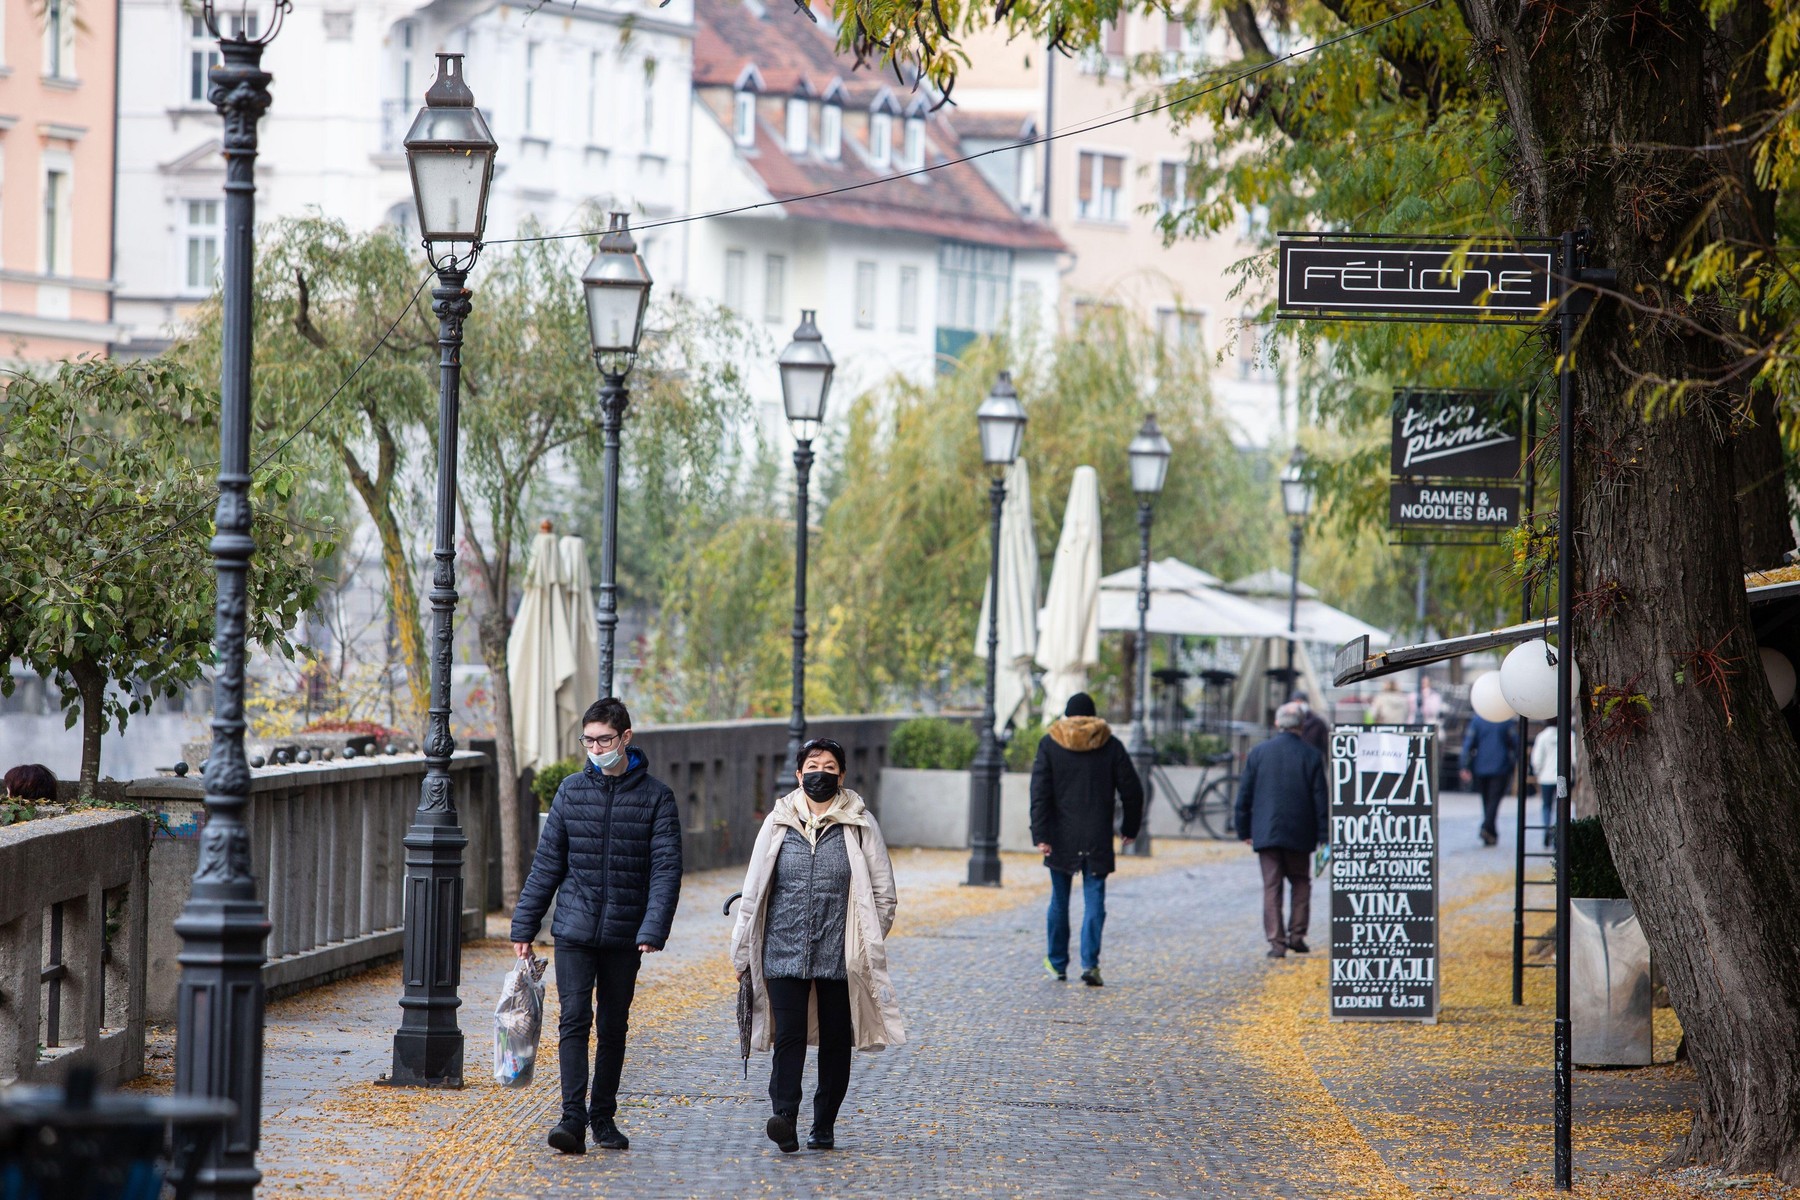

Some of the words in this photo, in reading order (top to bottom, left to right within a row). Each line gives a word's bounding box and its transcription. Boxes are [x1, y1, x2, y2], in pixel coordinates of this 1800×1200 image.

[1420, 490, 1475, 506] RAMEN
[1478, 491, 1489, 506] &
[1400, 504, 1472, 520] NOODLES
[1476, 506, 1507, 521] BAR
[1332, 758, 1432, 805] PIZZA
[1332, 815, 1433, 844] FOCACCIA
[1333, 860, 1367, 877] GIN
[1377, 860, 1430, 877] TONIC
[1333, 883, 1387, 891] SLOVENSKA
[1347, 892, 1413, 916] VINA
[1351, 923, 1410, 943] PIVA
[1332, 957, 1434, 981] KOKTAJLI
[1334, 995, 1383, 1008] LEDENI
[1389, 991, 1426, 1008] ČAJI
